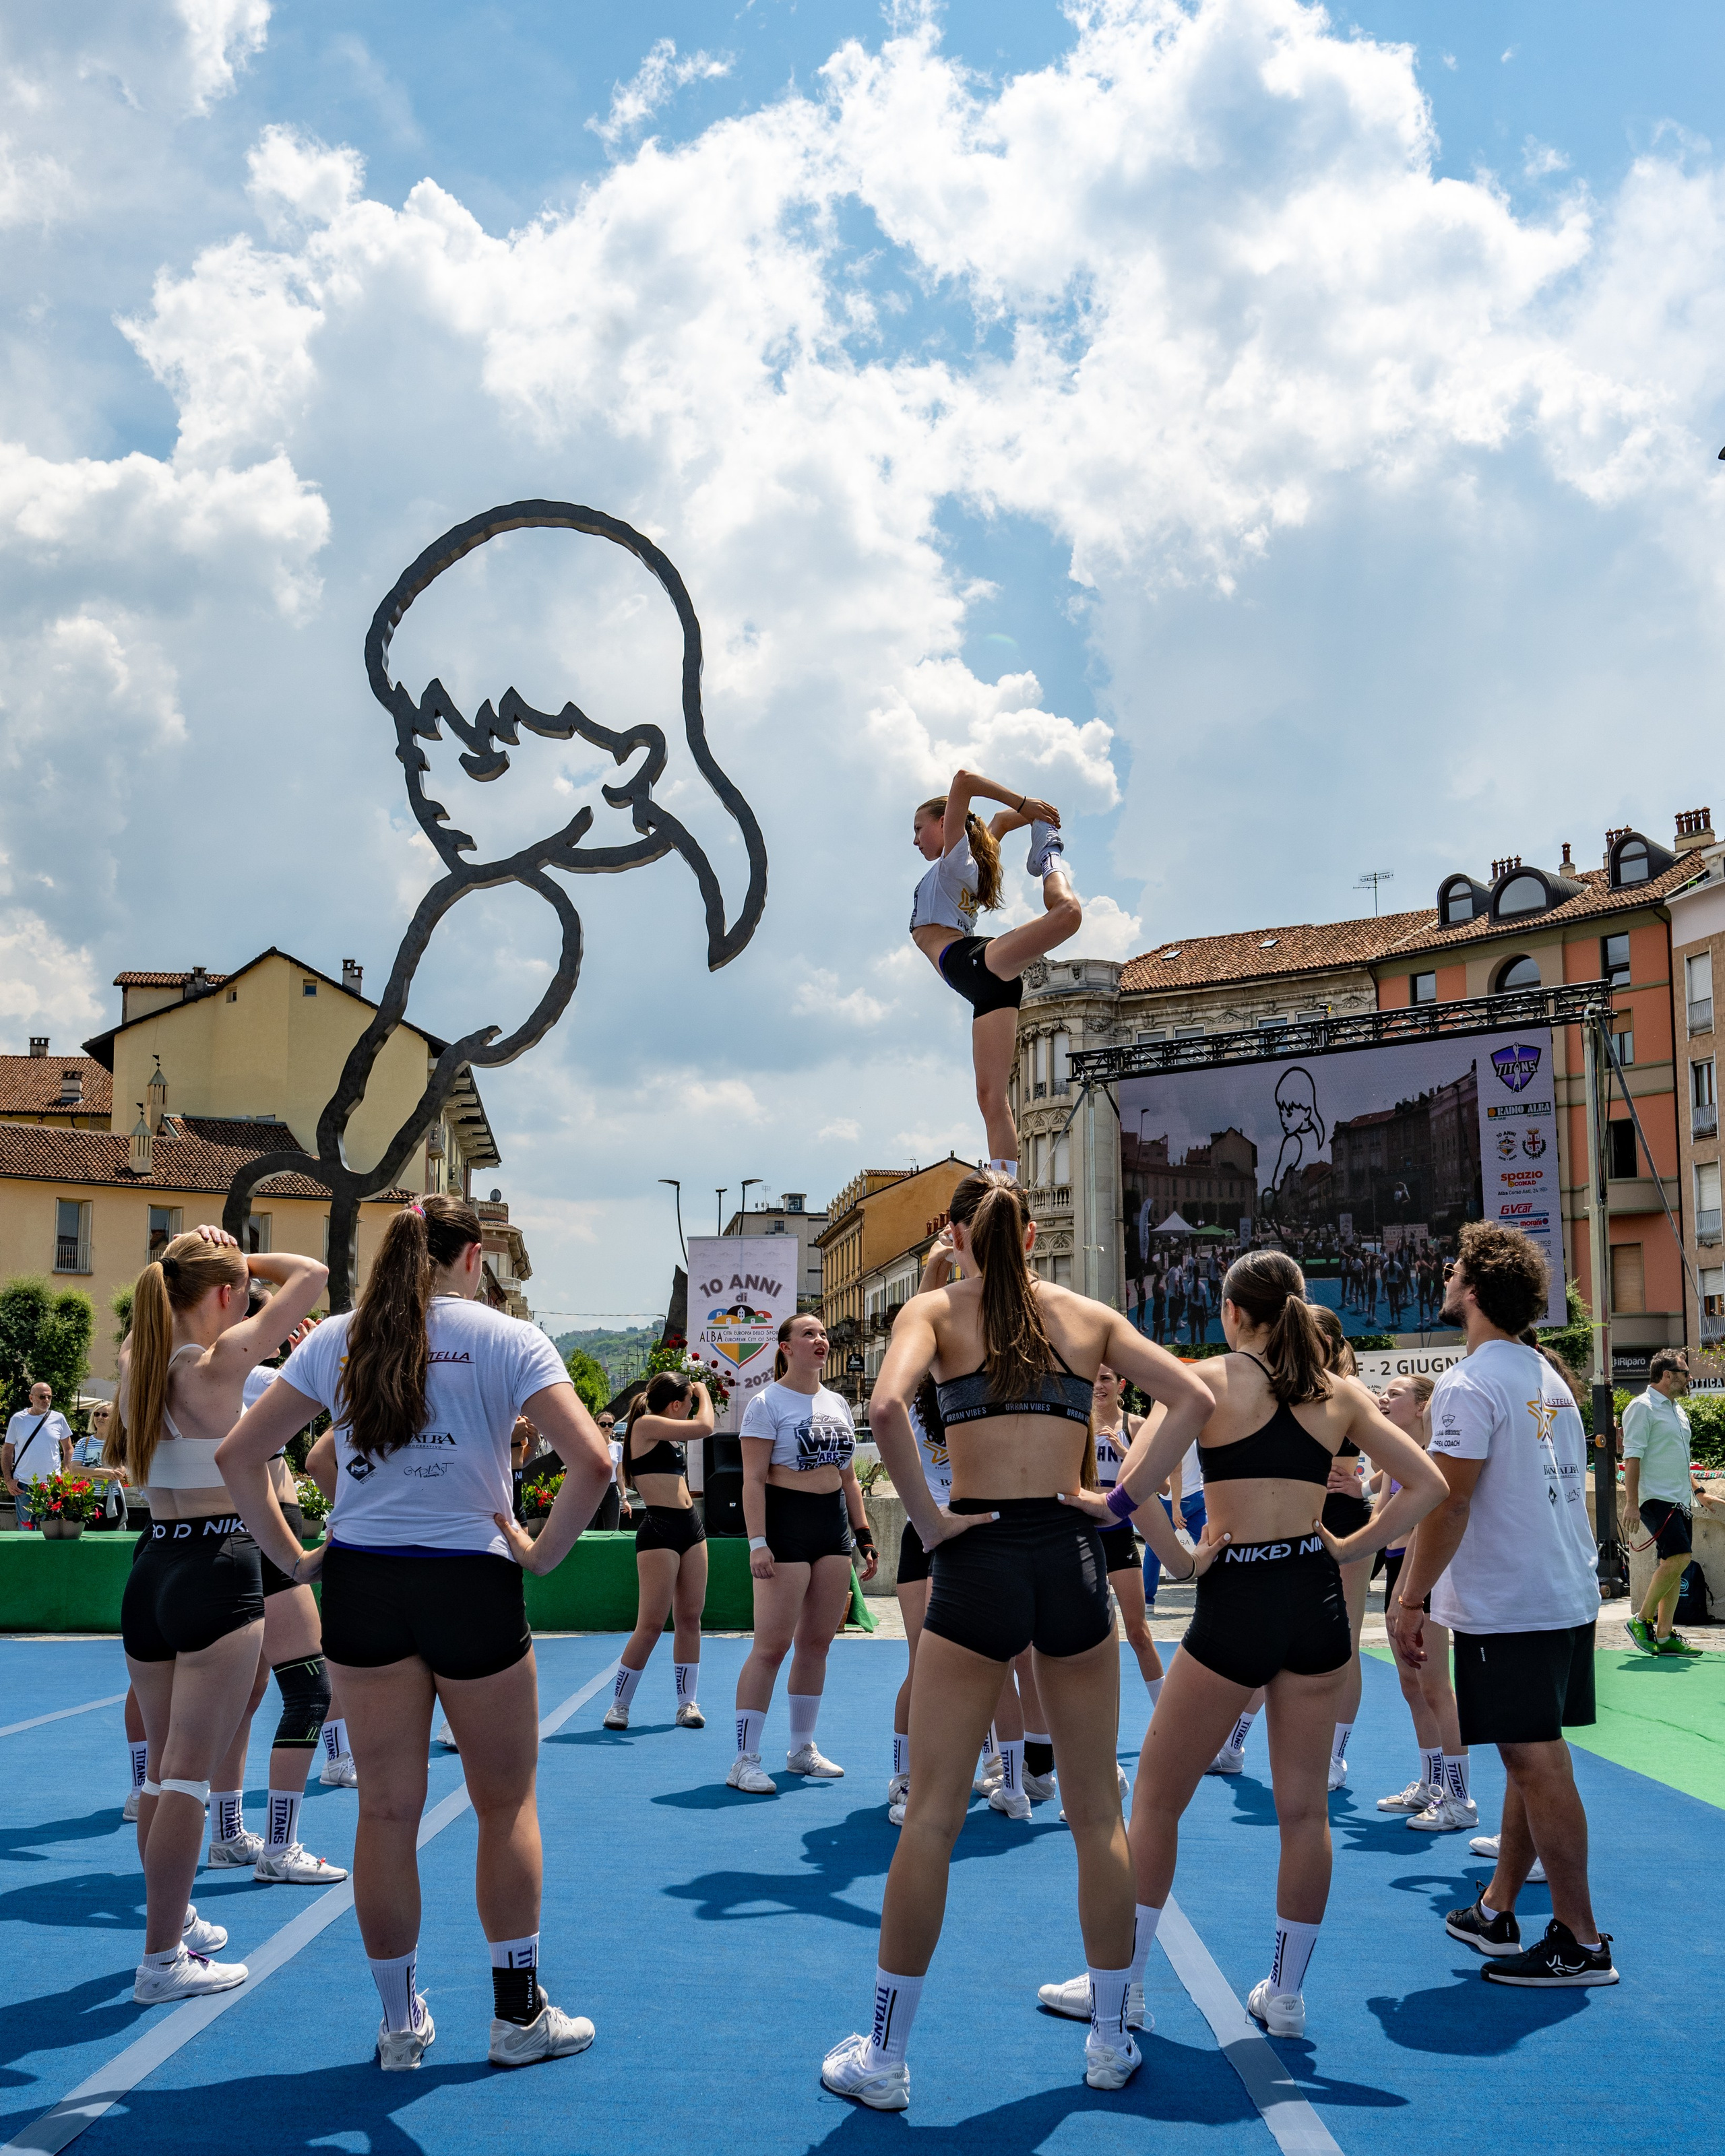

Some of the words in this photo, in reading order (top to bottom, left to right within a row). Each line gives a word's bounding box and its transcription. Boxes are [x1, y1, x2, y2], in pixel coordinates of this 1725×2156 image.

[1497, 1106, 1524, 1116] RADIO
[1527, 1102, 1550, 1113] ALBA
[1501, 1171, 1543, 1183] spazio
[699, 1278, 723, 1298] 10
[728, 1273, 783, 1298] ANNI
[735, 1292, 748, 1302] di
[699, 1331, 723, 1342] ALBA
[429, 1351, 470, 1360] TELLA
[1380, 1361, 1391, 1375] 2
[946, 1411, 965, 1422] URBAN
[966, 1407, 987, 1418] VIBES
[1005, 1402, 1028, 1412] URBAN
[1030, 1403, 1050, 1412] VIBES
[796, 1426, 854, 1454] WE
[817, 1451, 840, 1462] ARE
[202, 1518, 249, 1536] NIK
[1299, 1535, 1325, 1555] NIK
[615, 1670, 625, 1697] TITANS
[323, 1727, 336, 1761] TITANS
[1234, 1721, 1251, 1750] TITANS
[1001, 1750, 1011, 1789] TITANS
[1432, 1753, 1441, 1785] TITANS
[1447, 1763, 1466, 1800] TITANS
[225, 1799, 237, 1839] TITANS
[273, 1798, 288, 1845] TITANS
[871, 1987, 889, 2046] TITANS
